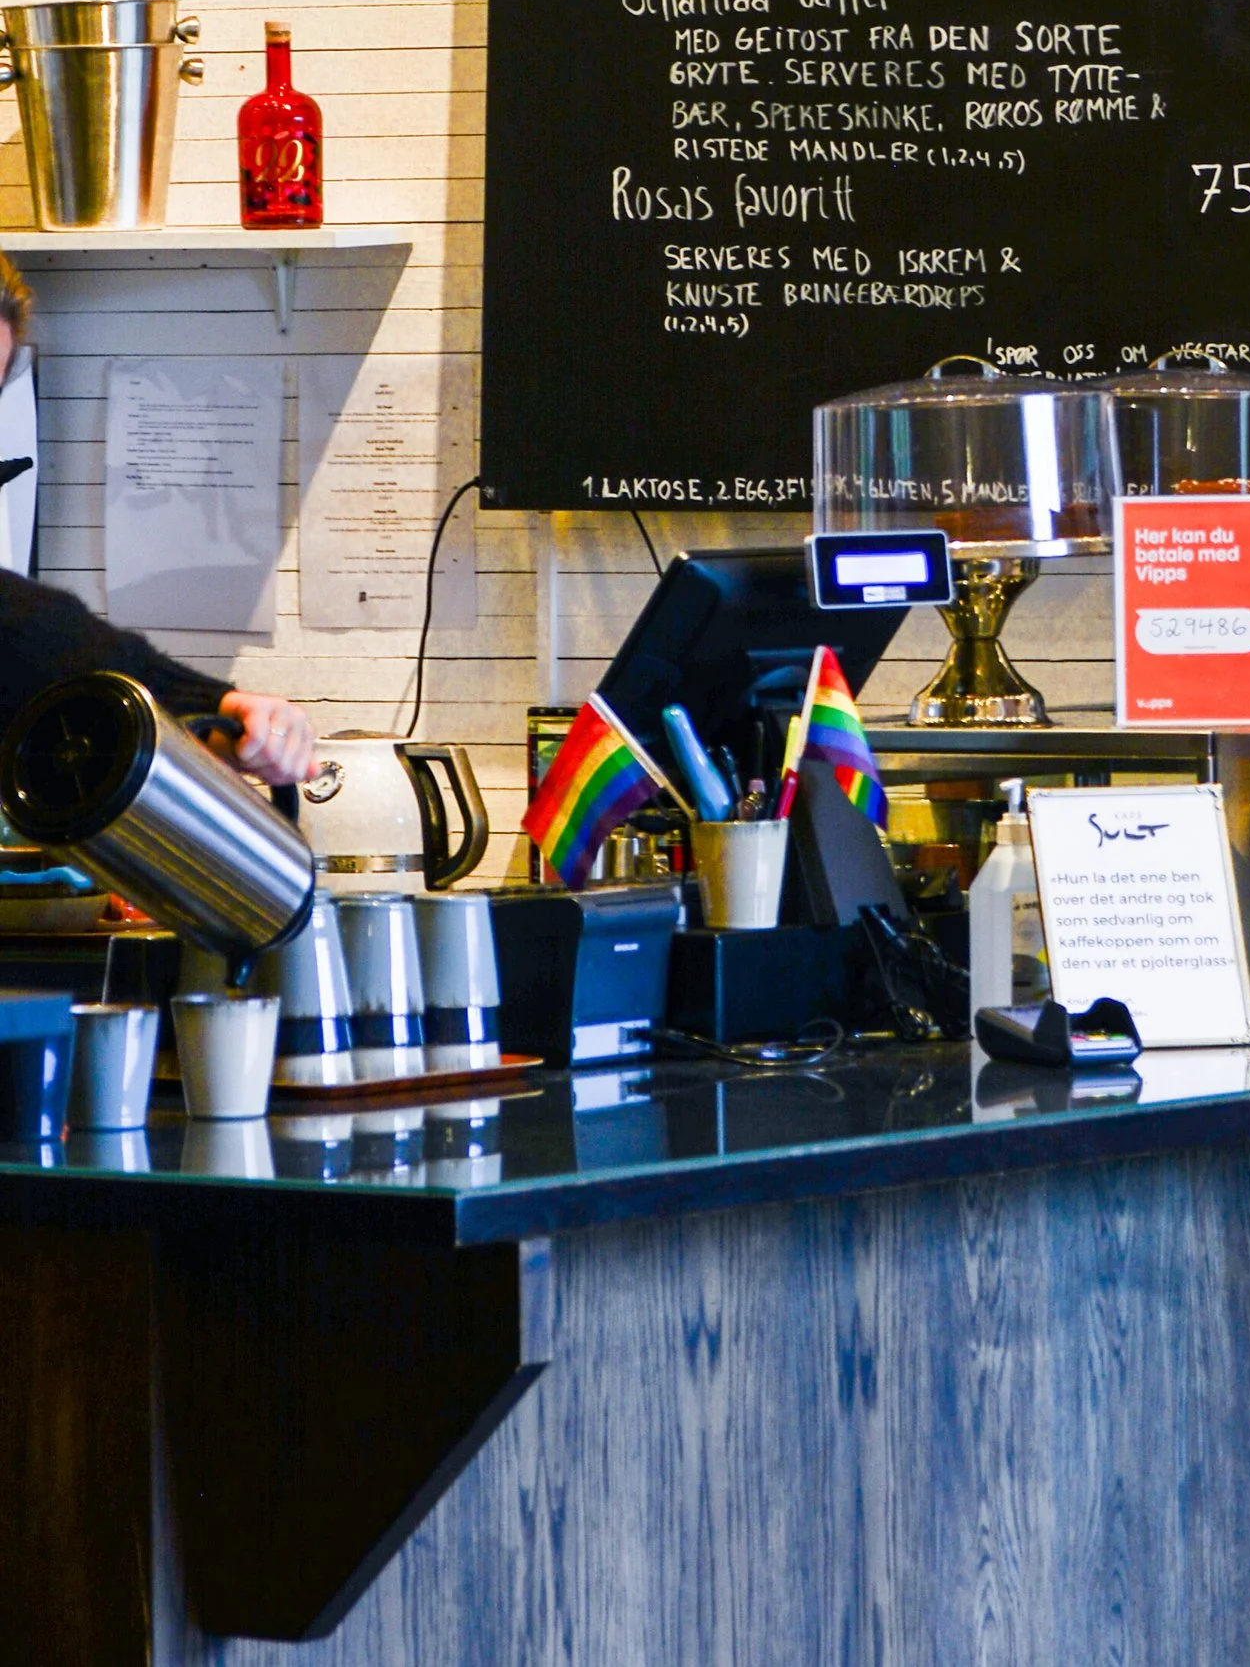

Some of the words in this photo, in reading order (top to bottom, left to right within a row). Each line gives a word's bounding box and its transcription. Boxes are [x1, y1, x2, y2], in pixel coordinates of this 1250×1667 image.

[674, 28, 721, 56] MED
[868, 23, 914, 50] FRA
[928, 24, 990, 52] DEN
[1015, 20, 1122, 57] SORTE
[784, 57, 945, 89] SERVERES
[966, 61, 1027, 90] MED
[1046, 63, 1141, 94] TYTTE-
[965, 98, 1044, 130] RØROS
[1054, 94, 1140, 125] RØMME
[1150, 92, 1167, 120] &
[673, 137, 769, 162] RISTEDE
[789, 138, 919, 162] MANDLER
[612, 165, 714, 221] Rosas
[734, 172, 856, 228] favoritt
[663, 244, 791, 271] SERVERES
[812, 245, 872, 277] MED
[898, 247, 987, 276] ISKREM
[1000, 246, 1022, 273] &
[665, 280, 762, 308] KNUSTE
[783, 281, 985, 310] BRINGEBÆRDROPS
[1062, 343, 1095, 365] OSS
[1120, 344, 1148, 363] OM
[1135, 528, 1167, 545] Her
[1172, 527, 1206, 544] kan
[1210, 526, 1234, 544] du
[1135, 546, 1193, 563] betale
[1198, 546, 1240, 562] med
[1135, 566, 1187, 584] Vipps
[1150, 616, 1248, 638] 529486
[1094, 872, 1106, 884] la
[1110, 872, 1134, 883] det
[1140, 873, 1166, 883] ene
[1172, 870, 1200, 882] ben
[1053, 895, 1084, 906] over
[1090, 893, 1114, 905] det
[1119, 893, 1162, 904] andre
[1167, 895, 1185, 907] og
[1190, 891, 1214, 904] tok
[1056, 916, 1087, 926] som
[1093, 913, 1163, 928] sedvanlig
[1168, 914, 1193, 925] om
[1059, 935, 1153, 949] kaffekoppen
[1159, 936, 1190, 946] som
[1195, 935, 1219, 946] om
[1062, 958, 1090, 970] den
[1094, 958, 1117, 969] var
[1121, 958, 1137, 968] et
